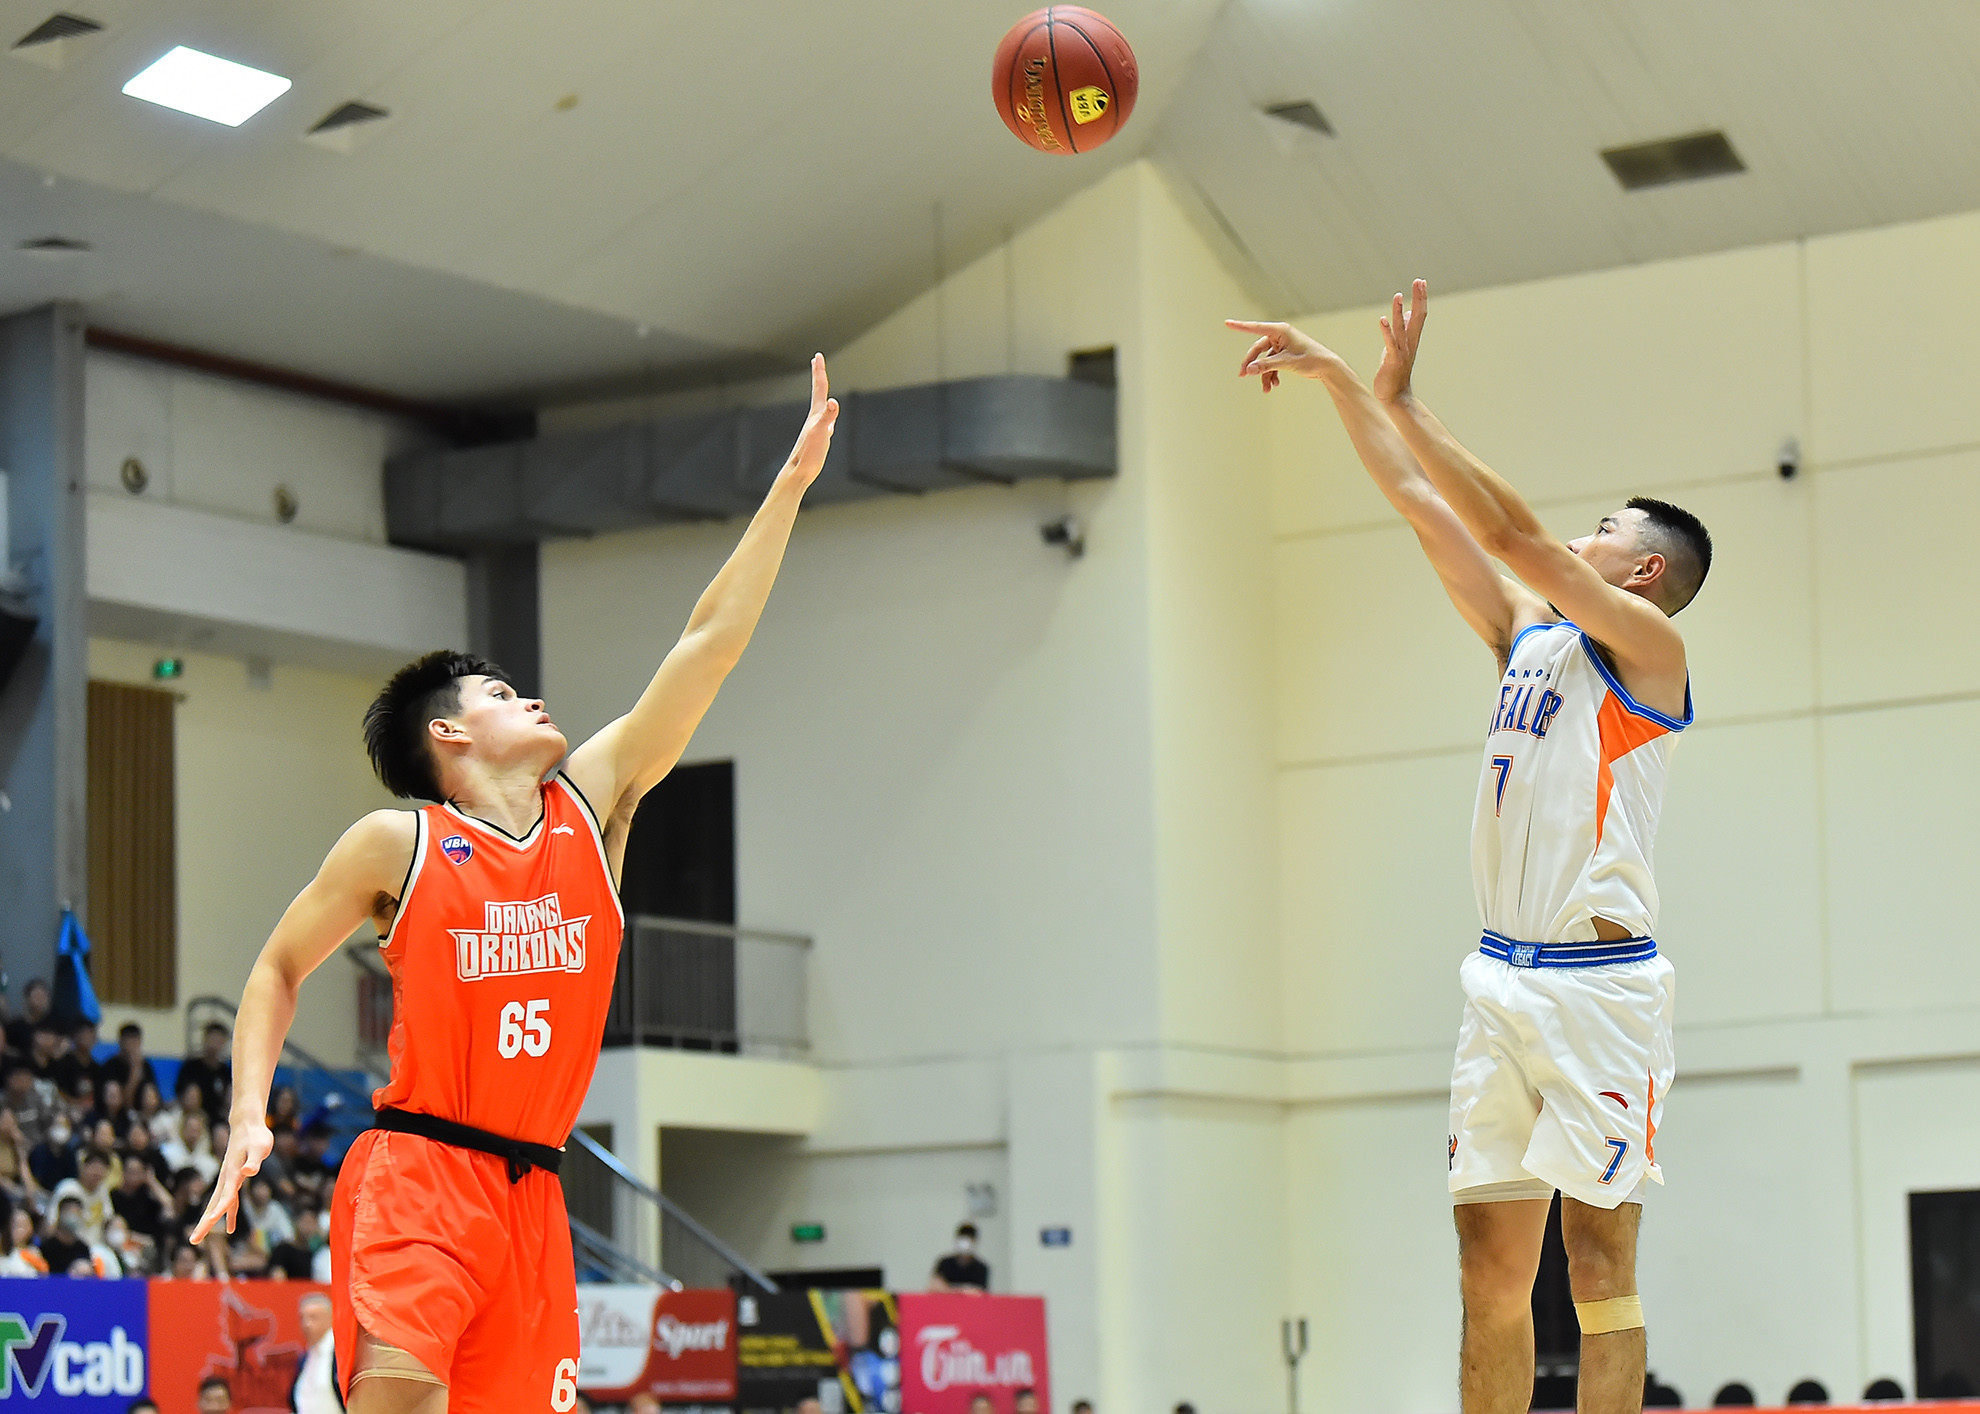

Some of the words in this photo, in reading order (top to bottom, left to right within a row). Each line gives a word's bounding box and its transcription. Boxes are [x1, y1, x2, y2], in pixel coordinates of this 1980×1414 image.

[1491, 755, 1514, 818] 7
[444, 835, 469, 849] VBA
[488, 896, 561, 934] DANANG
[456, 922, 586, 978] DRAGONS
[497, 998, 552, 1059] 65
[1597, 1136, 1630, 1185] 7
[654, 1313, 730, 1360] Sport
[550, 1357, 581, 1413] 6
